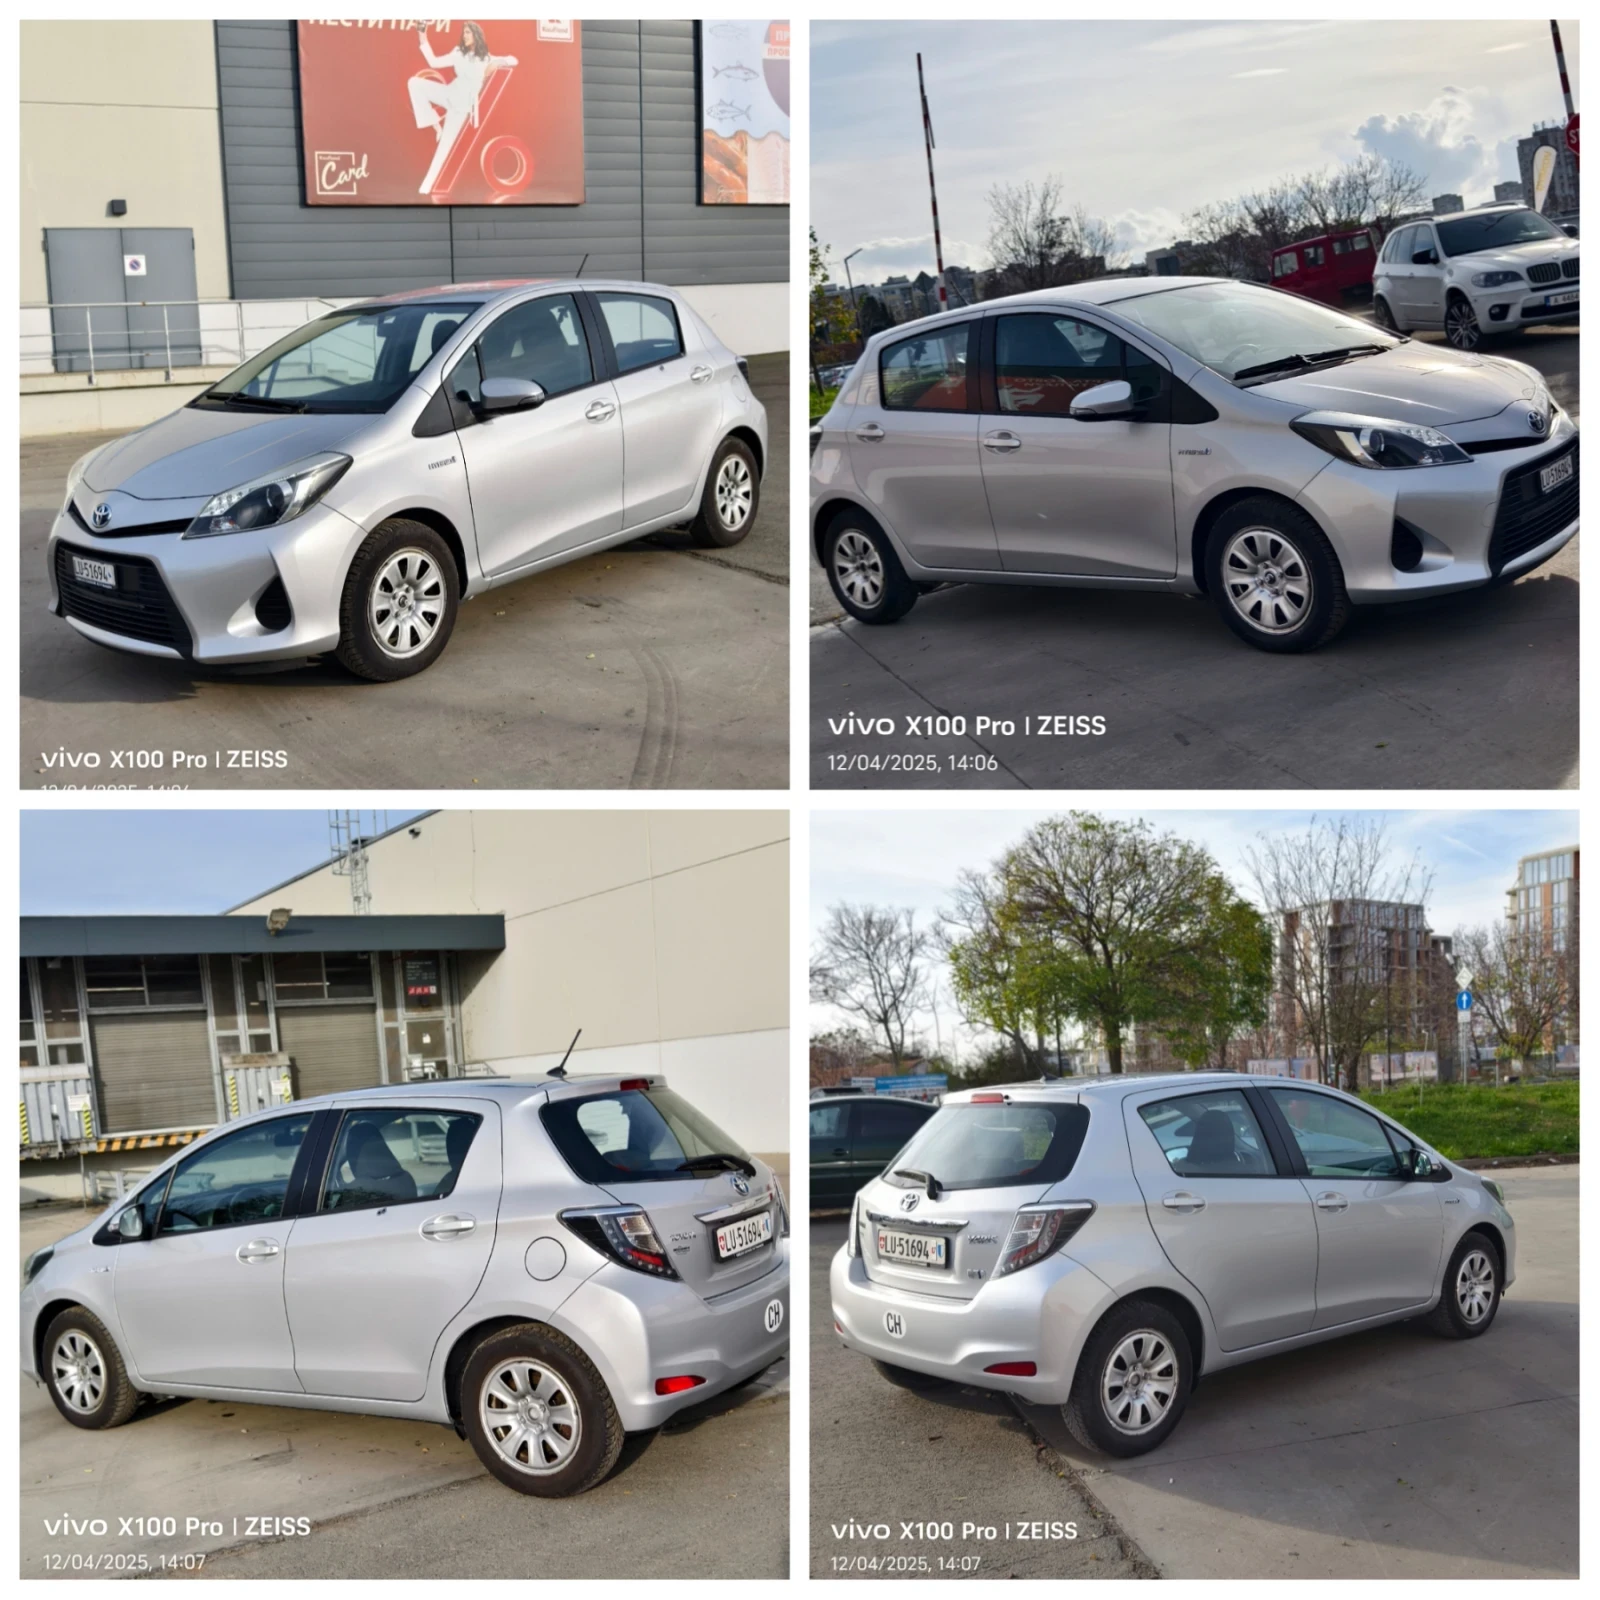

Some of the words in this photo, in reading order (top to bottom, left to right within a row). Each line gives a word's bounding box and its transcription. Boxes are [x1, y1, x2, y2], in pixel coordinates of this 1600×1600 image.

[321, 153, 370, 190] Card
[768, 1302, 780, 1329] CH
[886, 1312, 902, 1336] CH
